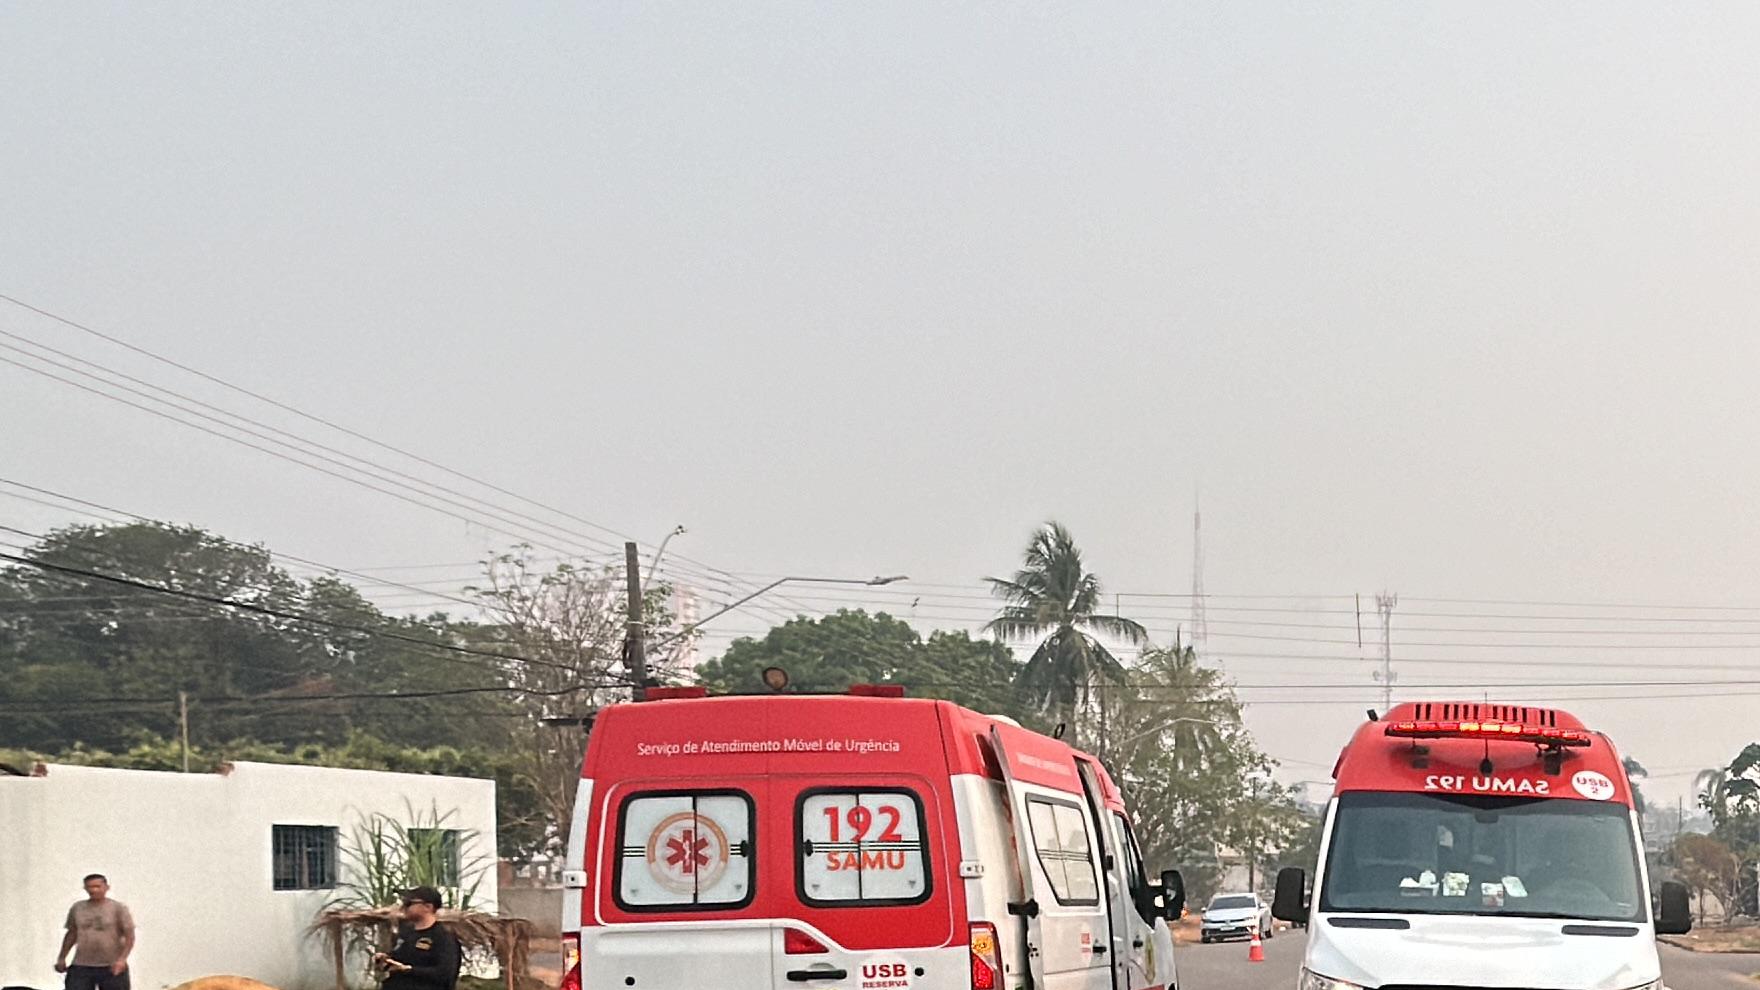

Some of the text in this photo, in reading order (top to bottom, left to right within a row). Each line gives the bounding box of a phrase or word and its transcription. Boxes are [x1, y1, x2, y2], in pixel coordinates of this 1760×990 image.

[637, 738, 900, 757] Serviço de Atendimento Móvel de Urgência
[823, 805, 902, 843] 192
[826, 849, 905, 871] SAMU
[862, 964, 907, 979] USB
[862, 980, 908, 989] RESERVA
